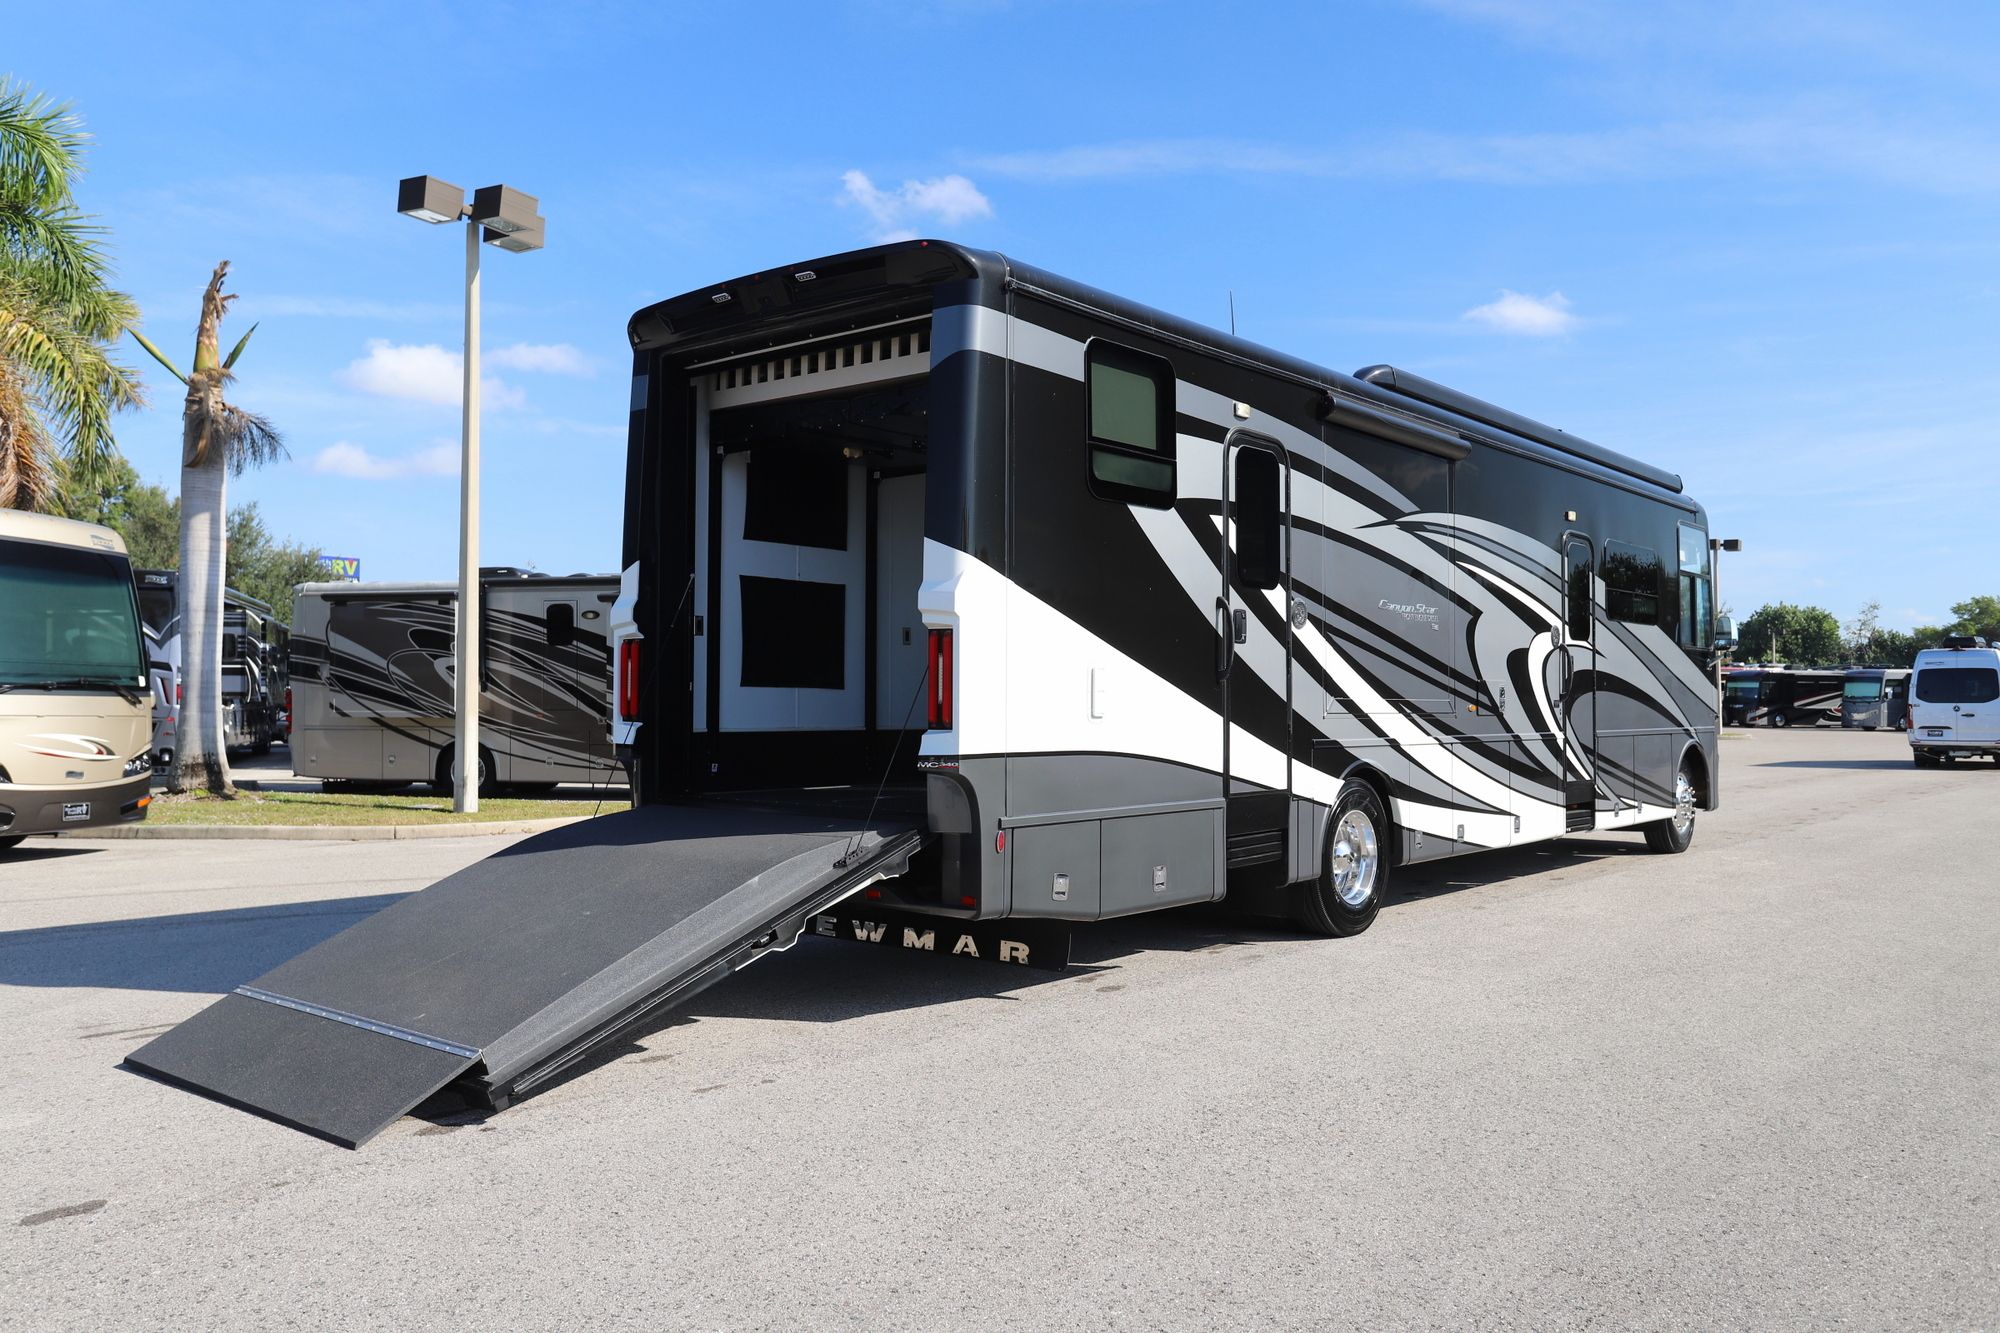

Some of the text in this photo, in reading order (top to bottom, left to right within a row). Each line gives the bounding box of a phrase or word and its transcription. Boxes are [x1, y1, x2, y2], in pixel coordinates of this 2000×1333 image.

[332, 559, 358, 576] RV
[1378, 599, 1439, 614] Canyon Star
[815, 914, 1031, 965] EWMAR
